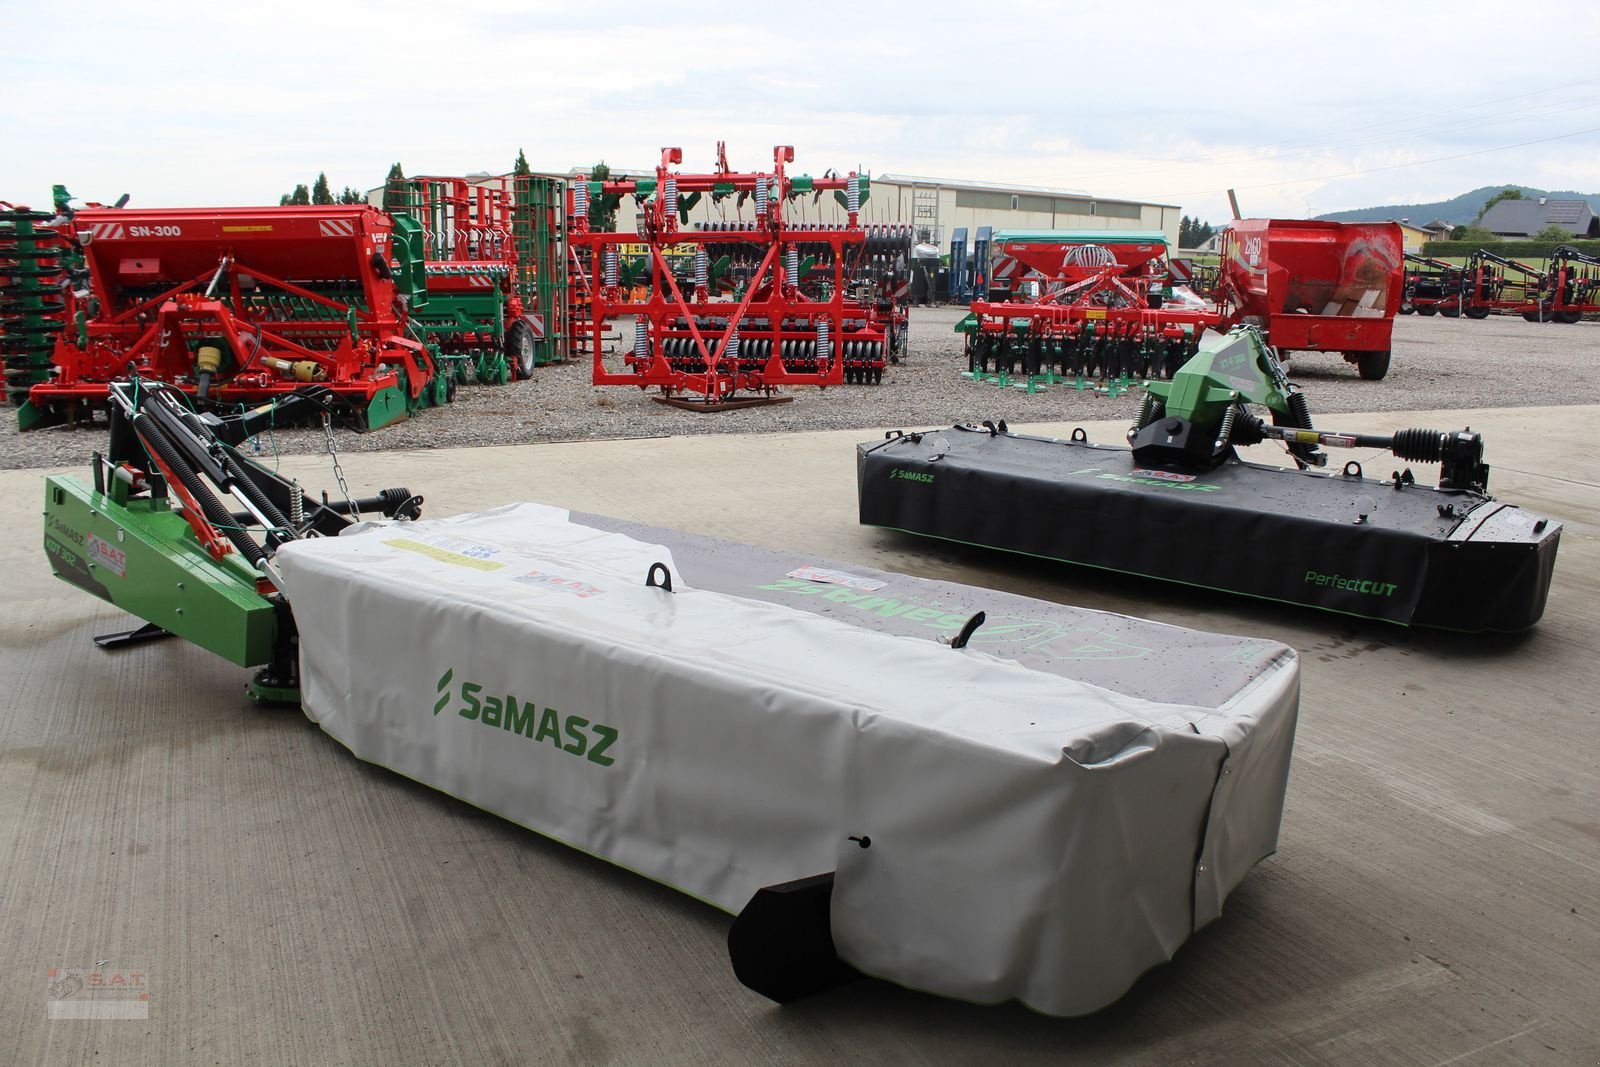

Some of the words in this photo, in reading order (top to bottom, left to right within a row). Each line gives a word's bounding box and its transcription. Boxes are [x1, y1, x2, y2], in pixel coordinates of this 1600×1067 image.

[129, 225, 181, 237] SN-300
[898, 470, 935, 483] SaMASZ
[1304, 570, 1398, 597] PerfectCUT
[458, 682, 619, 767] SaMASZ
